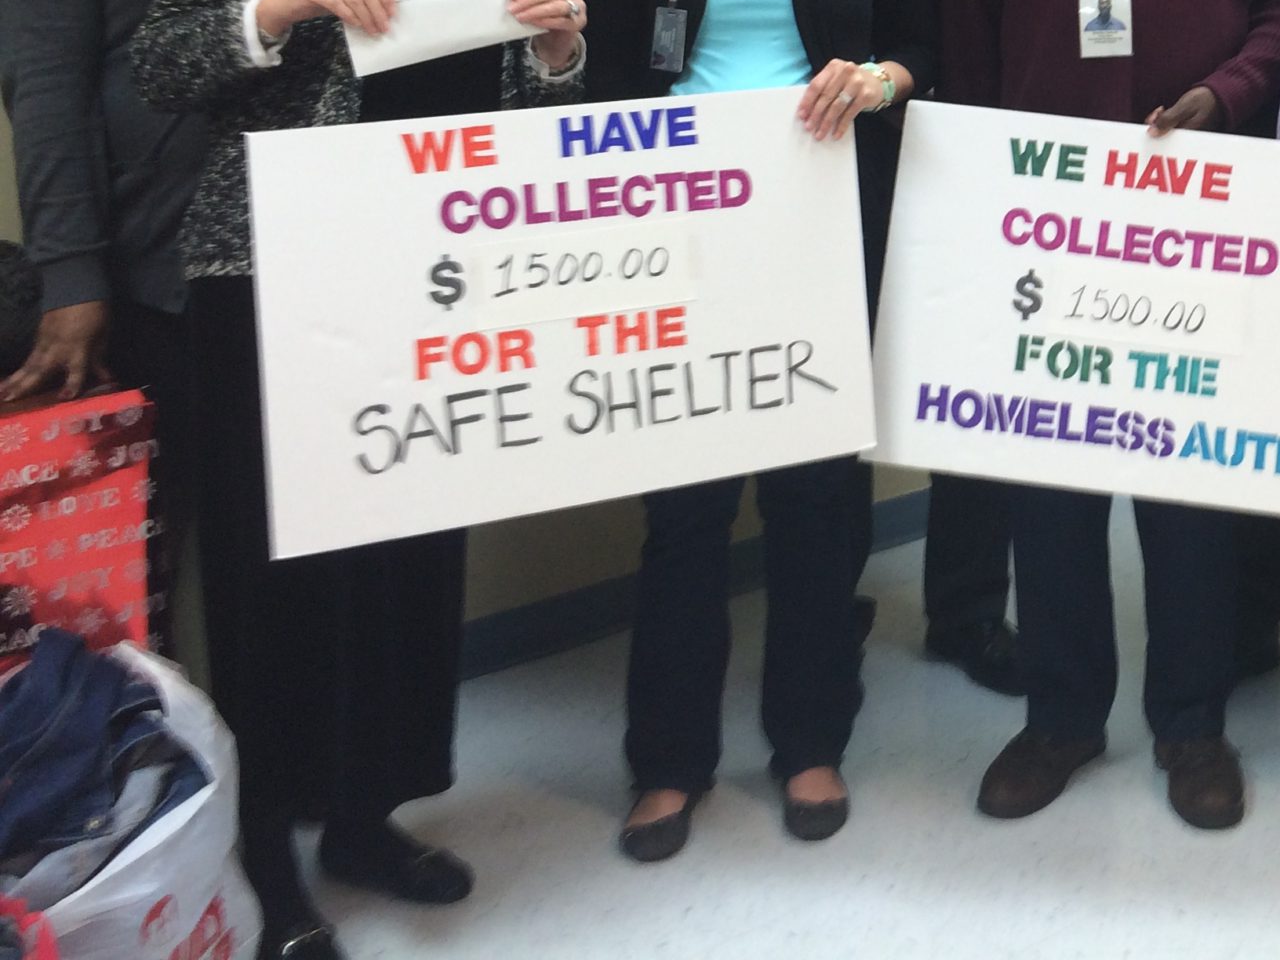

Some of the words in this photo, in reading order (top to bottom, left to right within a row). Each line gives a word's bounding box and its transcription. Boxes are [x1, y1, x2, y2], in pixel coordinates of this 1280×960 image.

[402, 125, 498, 174] WE
[559, 106, 698, 158] HAVE
[1009, 137, 1088, 182] WE
[1103, 149, 1234, 202] HAVE
[440, 169, 753, 234] COLLECTED
[1000, 207, 1280, 277] COLLECTED
[428, 253, 467, 311] $
[490, 246, 670, 298] 1500.00
[1012, 268, 1043, 321] $
[1064, 285, 1207, 334] 1500.00
[414, 328, 536, 381] FOR
[575, 305, 688, 357] THE
[1013, 333, 1114, 386] FOR
[1127, 350, 1221, 398] THE
[353, 382, 543, 475] SAFE
[565, 339, 839, 435] SHELTER
[915, 383, 1176, 459] HOMELESS
[38, 487, 121, 521] LOVE
